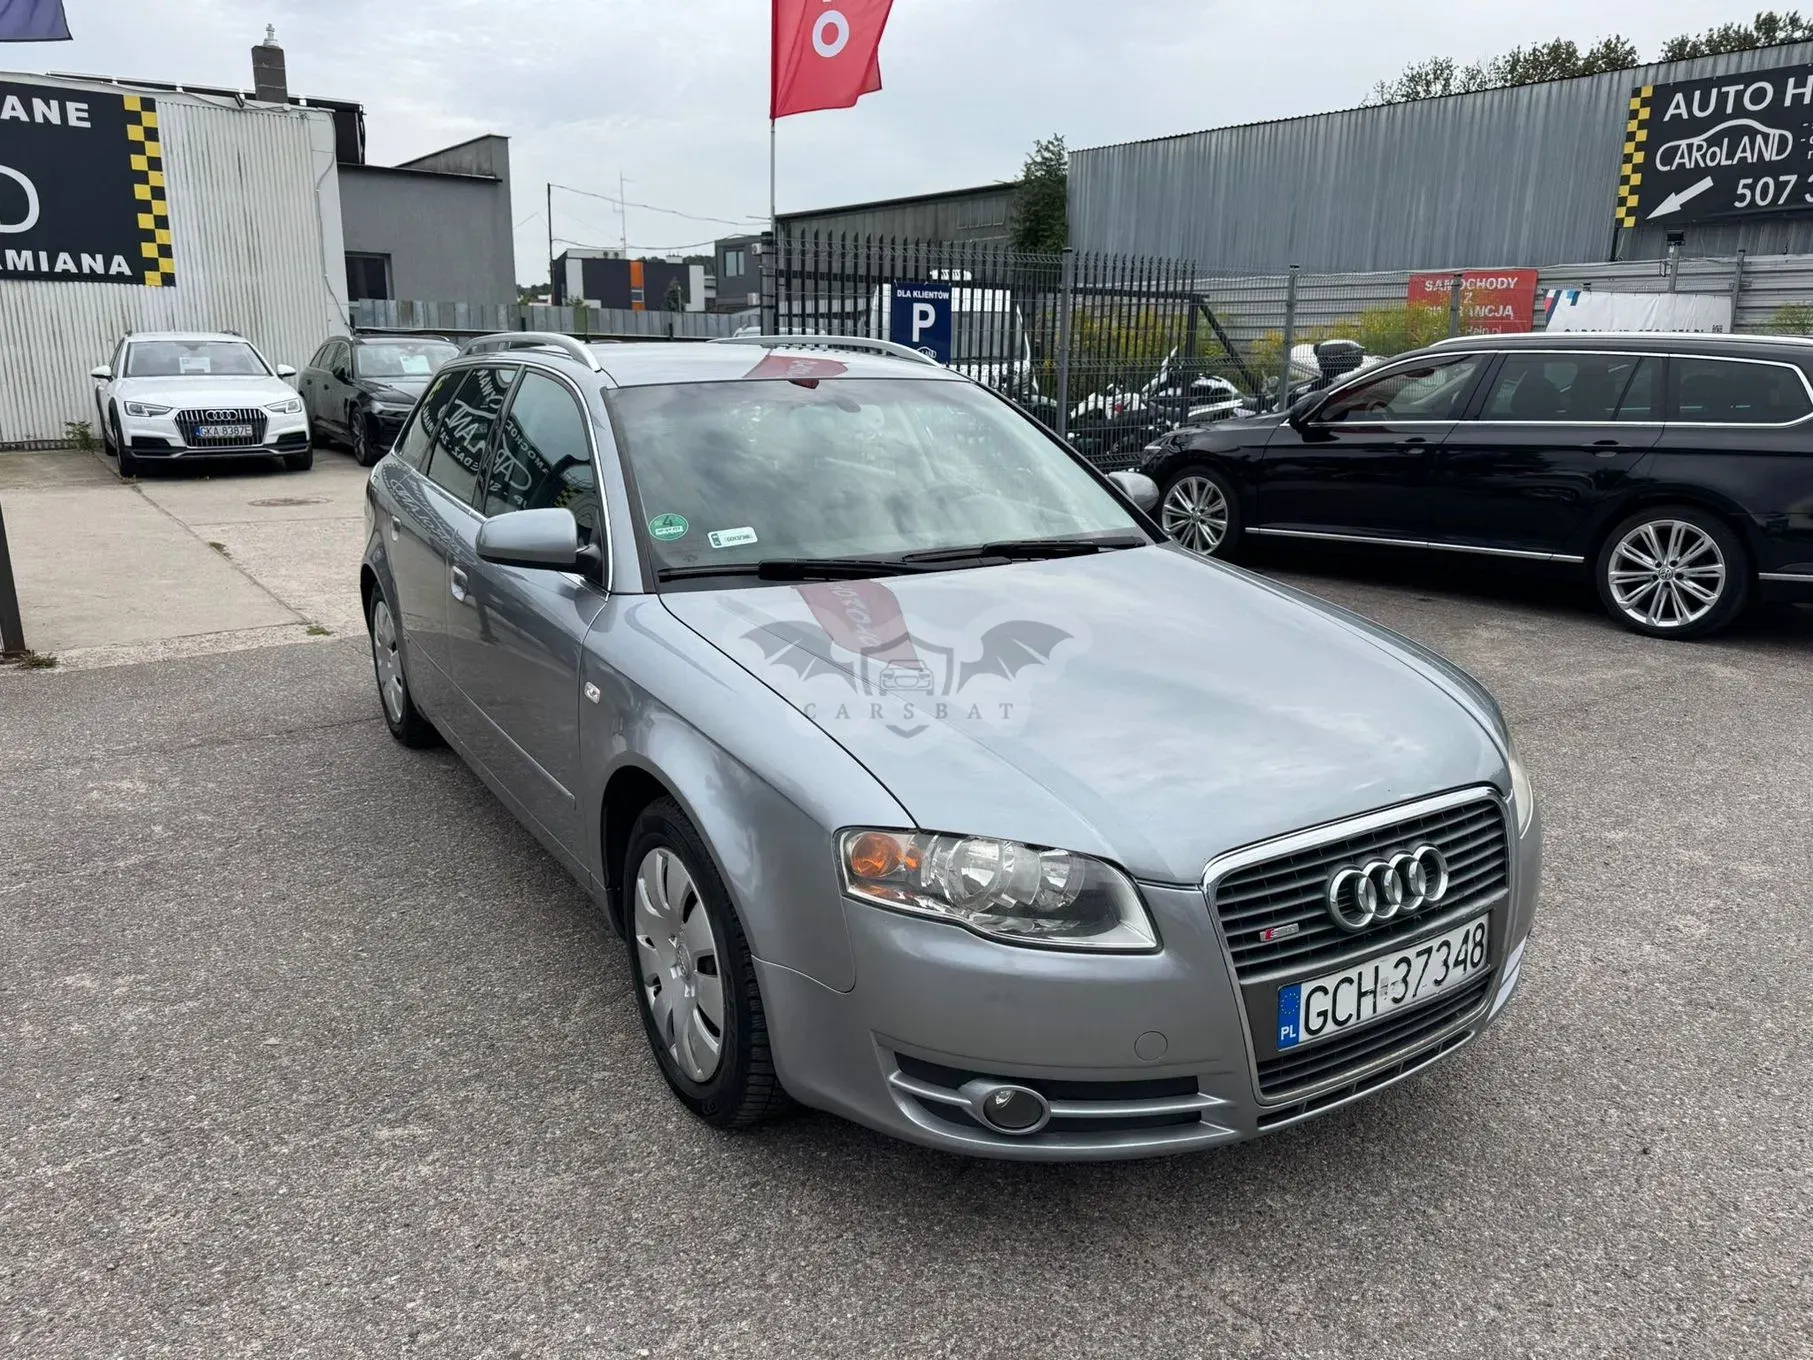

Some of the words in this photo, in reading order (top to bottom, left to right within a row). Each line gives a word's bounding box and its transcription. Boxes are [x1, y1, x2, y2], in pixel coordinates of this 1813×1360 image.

[1663, 81, 1774, 122] AUTO
[1734, 174, 1798, 208] 507
[0, 249, 133, 276] MIANA
[897, 290, 911, 298] DLA
[913, 290, 949, 299] KLIENTÓW
[912, 303, 936, 343] P
[222, 425, 252, 436] 8387E
[662, 515, 673, 527] 4
[1304, 965, 1380, 1036] GCH
[1391, 922, 1486, 1004] 37348
[1281, 1024, 1297, 1041] PL
